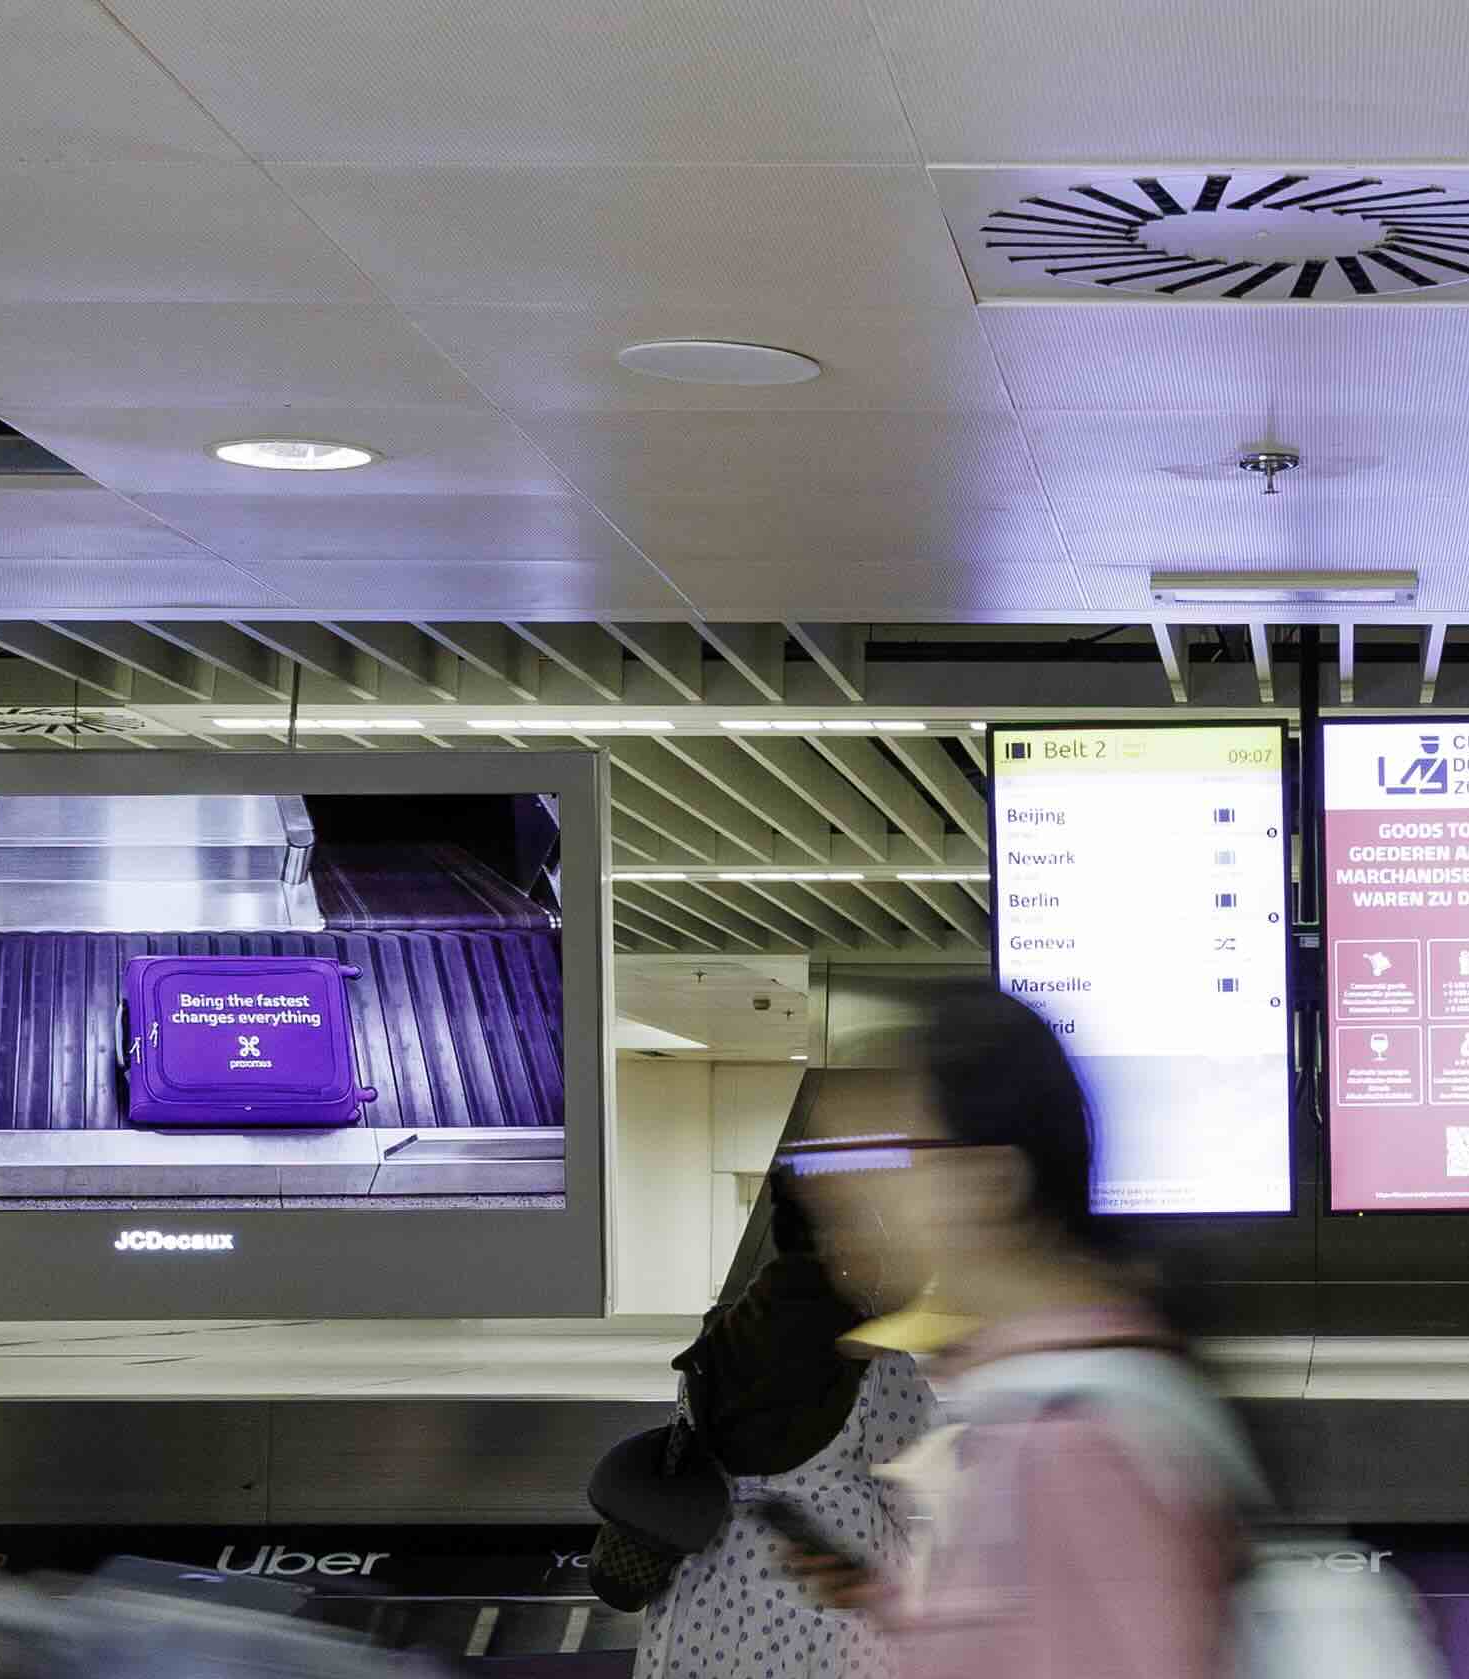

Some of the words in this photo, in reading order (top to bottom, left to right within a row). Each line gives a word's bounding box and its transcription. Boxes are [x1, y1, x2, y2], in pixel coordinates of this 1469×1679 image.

[1043, 740, 1087, 759] Belt
[1094, 740, 1107, 759] 2
[1227, 749, 1272, 764] 09:07
[1007, 808, 1066, 826] Beijing
[1379, 822, 1443, 840] GOODS
[1008, 851, 1076, 865] Newark
[1349, 845, 1450, 863] GOEDEREN
[1009, 893, 1059, 907] Berlin
[1352, 891, 1424, 908] WAREN
[1428, 890, 1452, 907] ZU
[1010, 936, 1075, 950] Geneva
[1011, 977, 1092, 993] Marseille
[180, 994, 224, 1011] Being
[227, 994, 253, 1007] the
[256, 994, 310, 1007] fastest
[172, 1010, 235, 1027] changes
[238, 1010, 322, 1027] everything
[114, 1230, 235, 1251] JCDecaux
[216, 1544, 391, 1575] Uber
